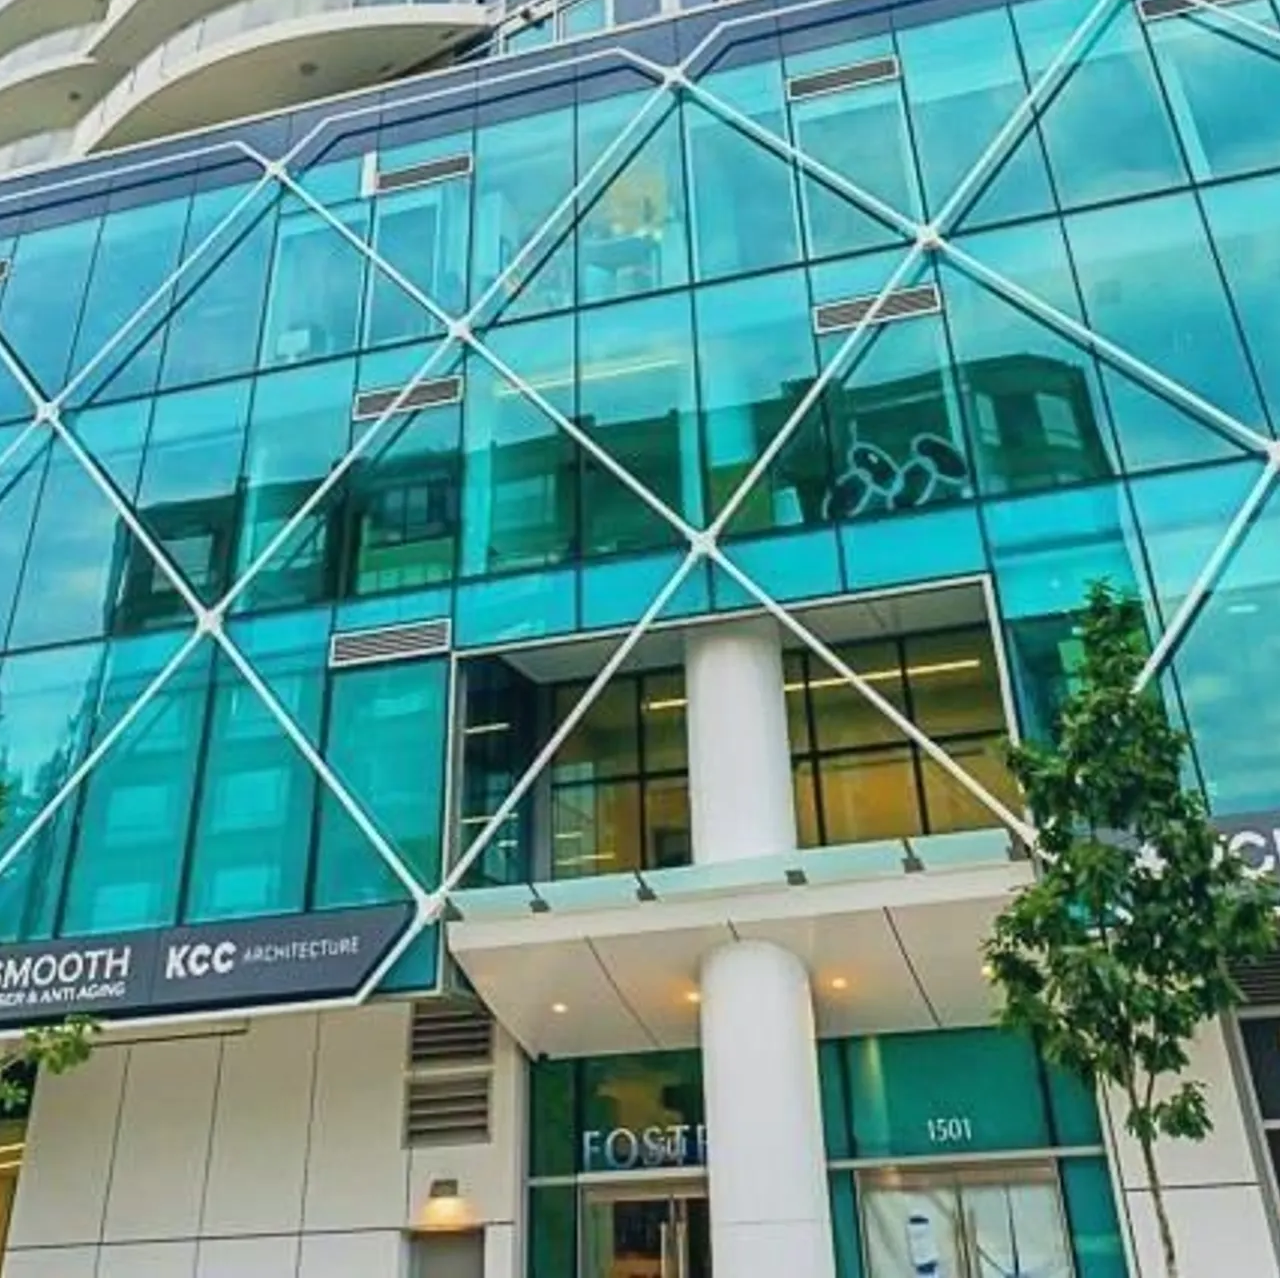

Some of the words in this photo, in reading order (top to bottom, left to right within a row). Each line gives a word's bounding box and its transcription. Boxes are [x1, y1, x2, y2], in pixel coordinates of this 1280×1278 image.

[165, 940, 238, 980] KCC
[243, 935, 360, 964] ARCHITECTURE
[39, 986, 74, 1004] ANTI
[76, 980, 126, 1001] AGING
[928, 1117, 972, 1141] 1501
